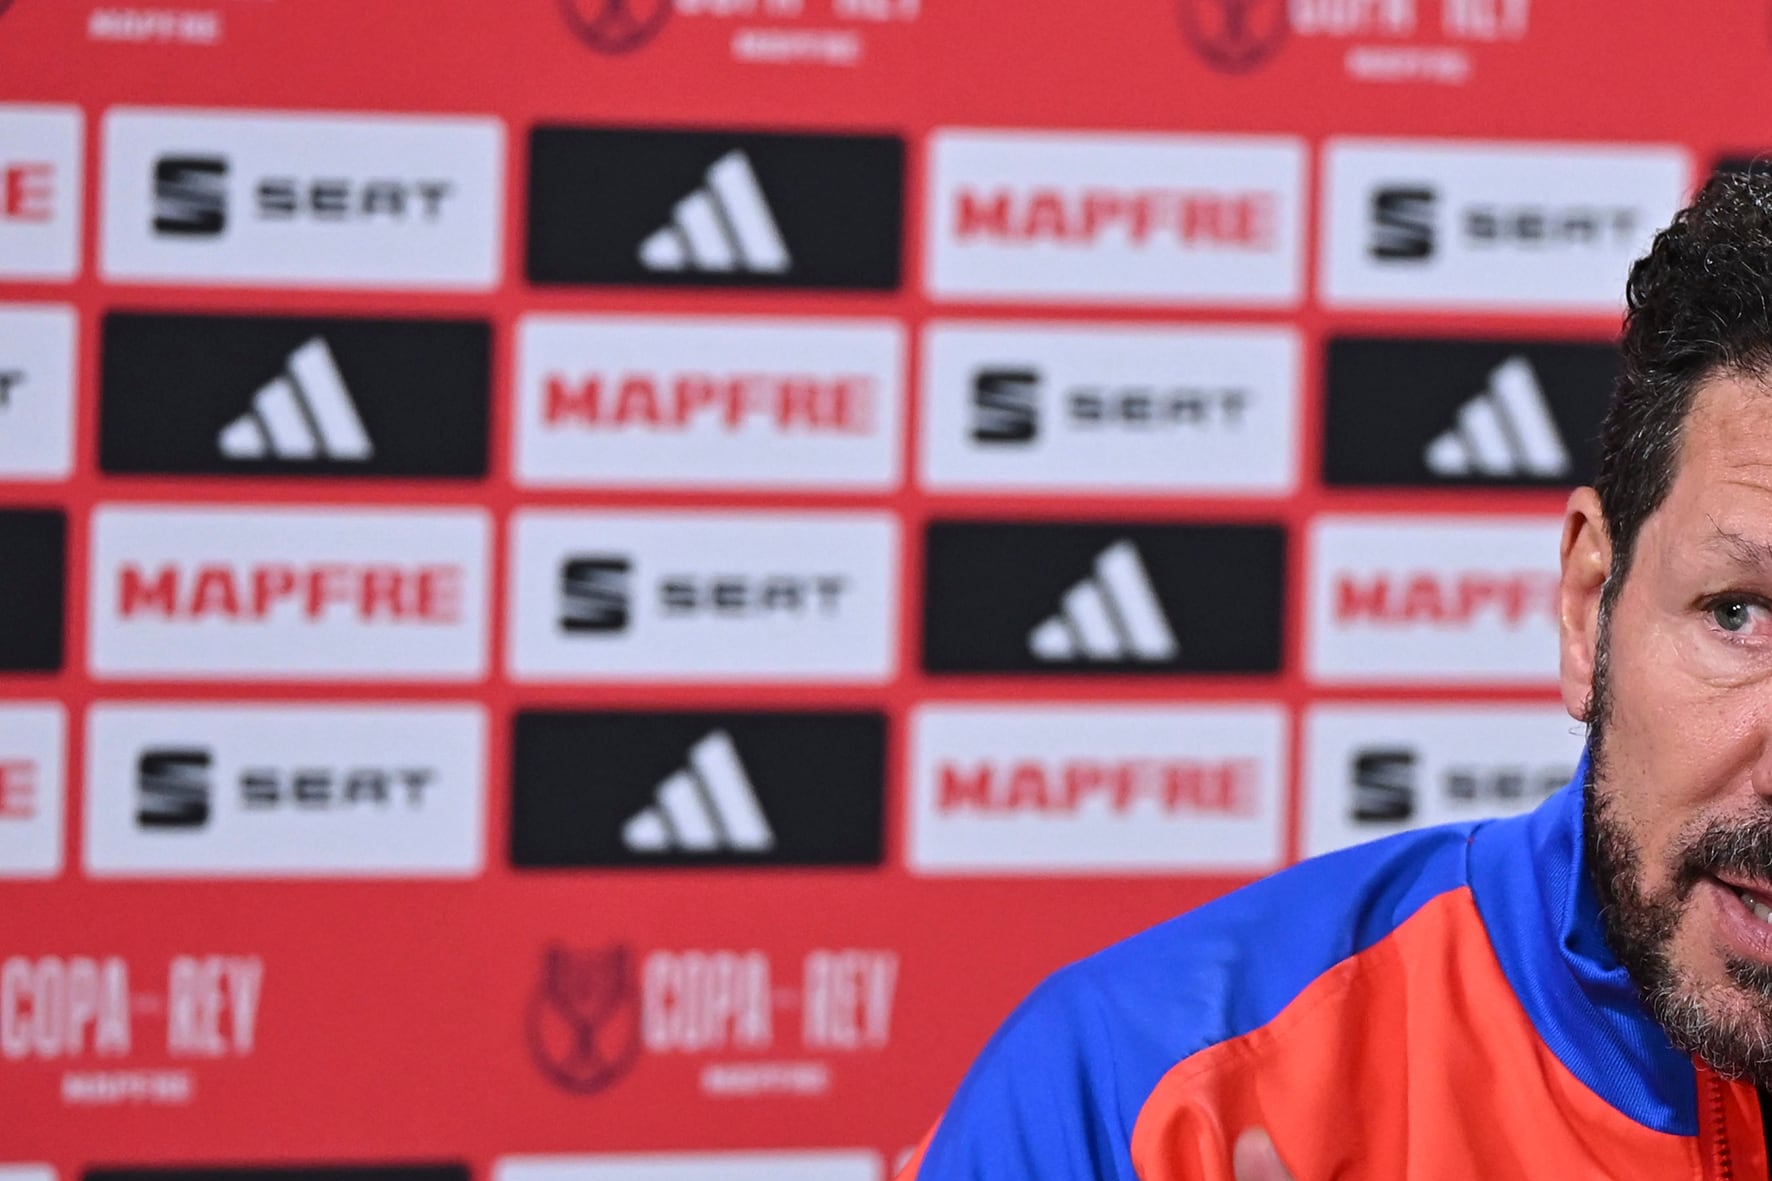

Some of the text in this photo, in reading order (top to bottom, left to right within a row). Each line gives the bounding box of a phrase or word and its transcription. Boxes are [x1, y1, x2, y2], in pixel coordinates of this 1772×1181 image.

[255, 179, 453, 220] SEAT
[953, 190, 1276, 248] MAPFRE
[542, 374, 873, 432] MAPFRE
[1067, 390, 1251, 427] SEAT
[117, 565, 460, 621] MAPFRE
[658, 577, 849, 615] SEAT
[1333, 573, 1561, 628] MAPF
[238, 769, 436, 809] SEAT
[936, 761, 1258, 815] MAPFRE
[0, 956, 262, 1058] COPA REY
[803, 950, 897, 1049] REY
